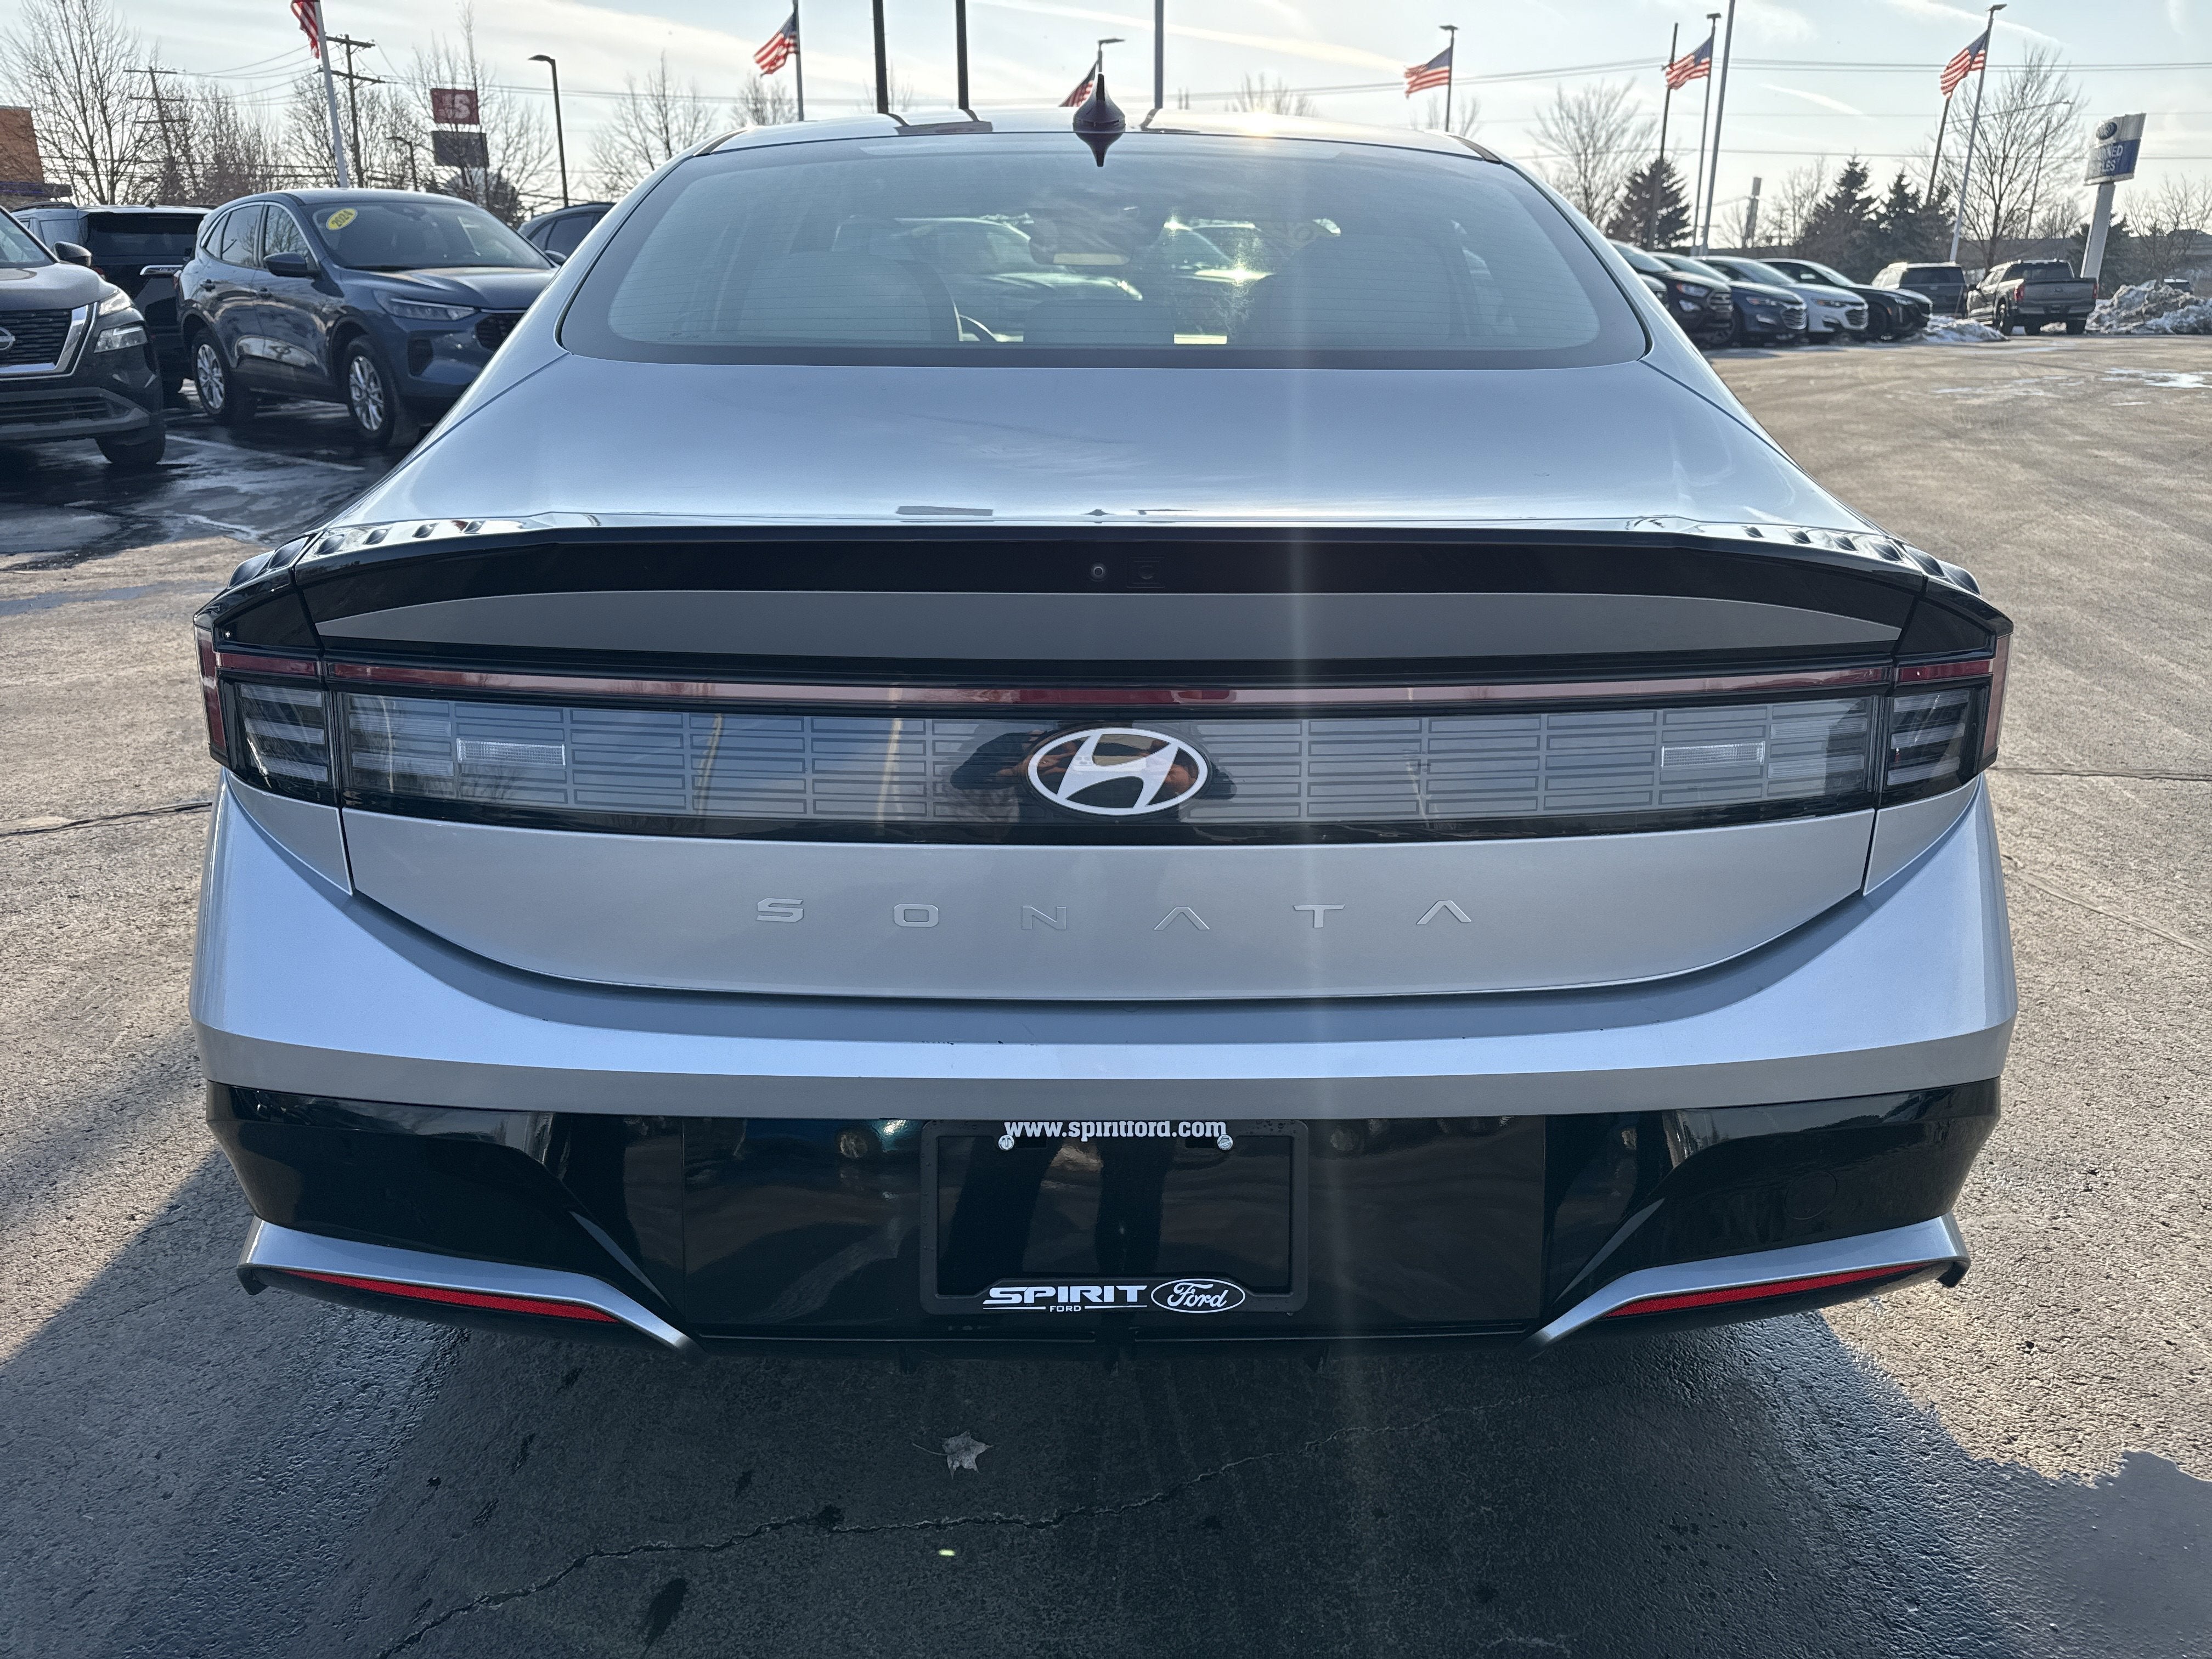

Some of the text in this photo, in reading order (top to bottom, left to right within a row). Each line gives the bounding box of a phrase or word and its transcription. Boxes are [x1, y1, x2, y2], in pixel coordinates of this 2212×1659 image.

[331, 210, 354, 227] 2024
[757, 898, 1472, 930] SONATA
[1004, 1121, 1227, 1142] www.spiritford.com
[983, 1282, 1229, 1308] SPIRIT Ford
